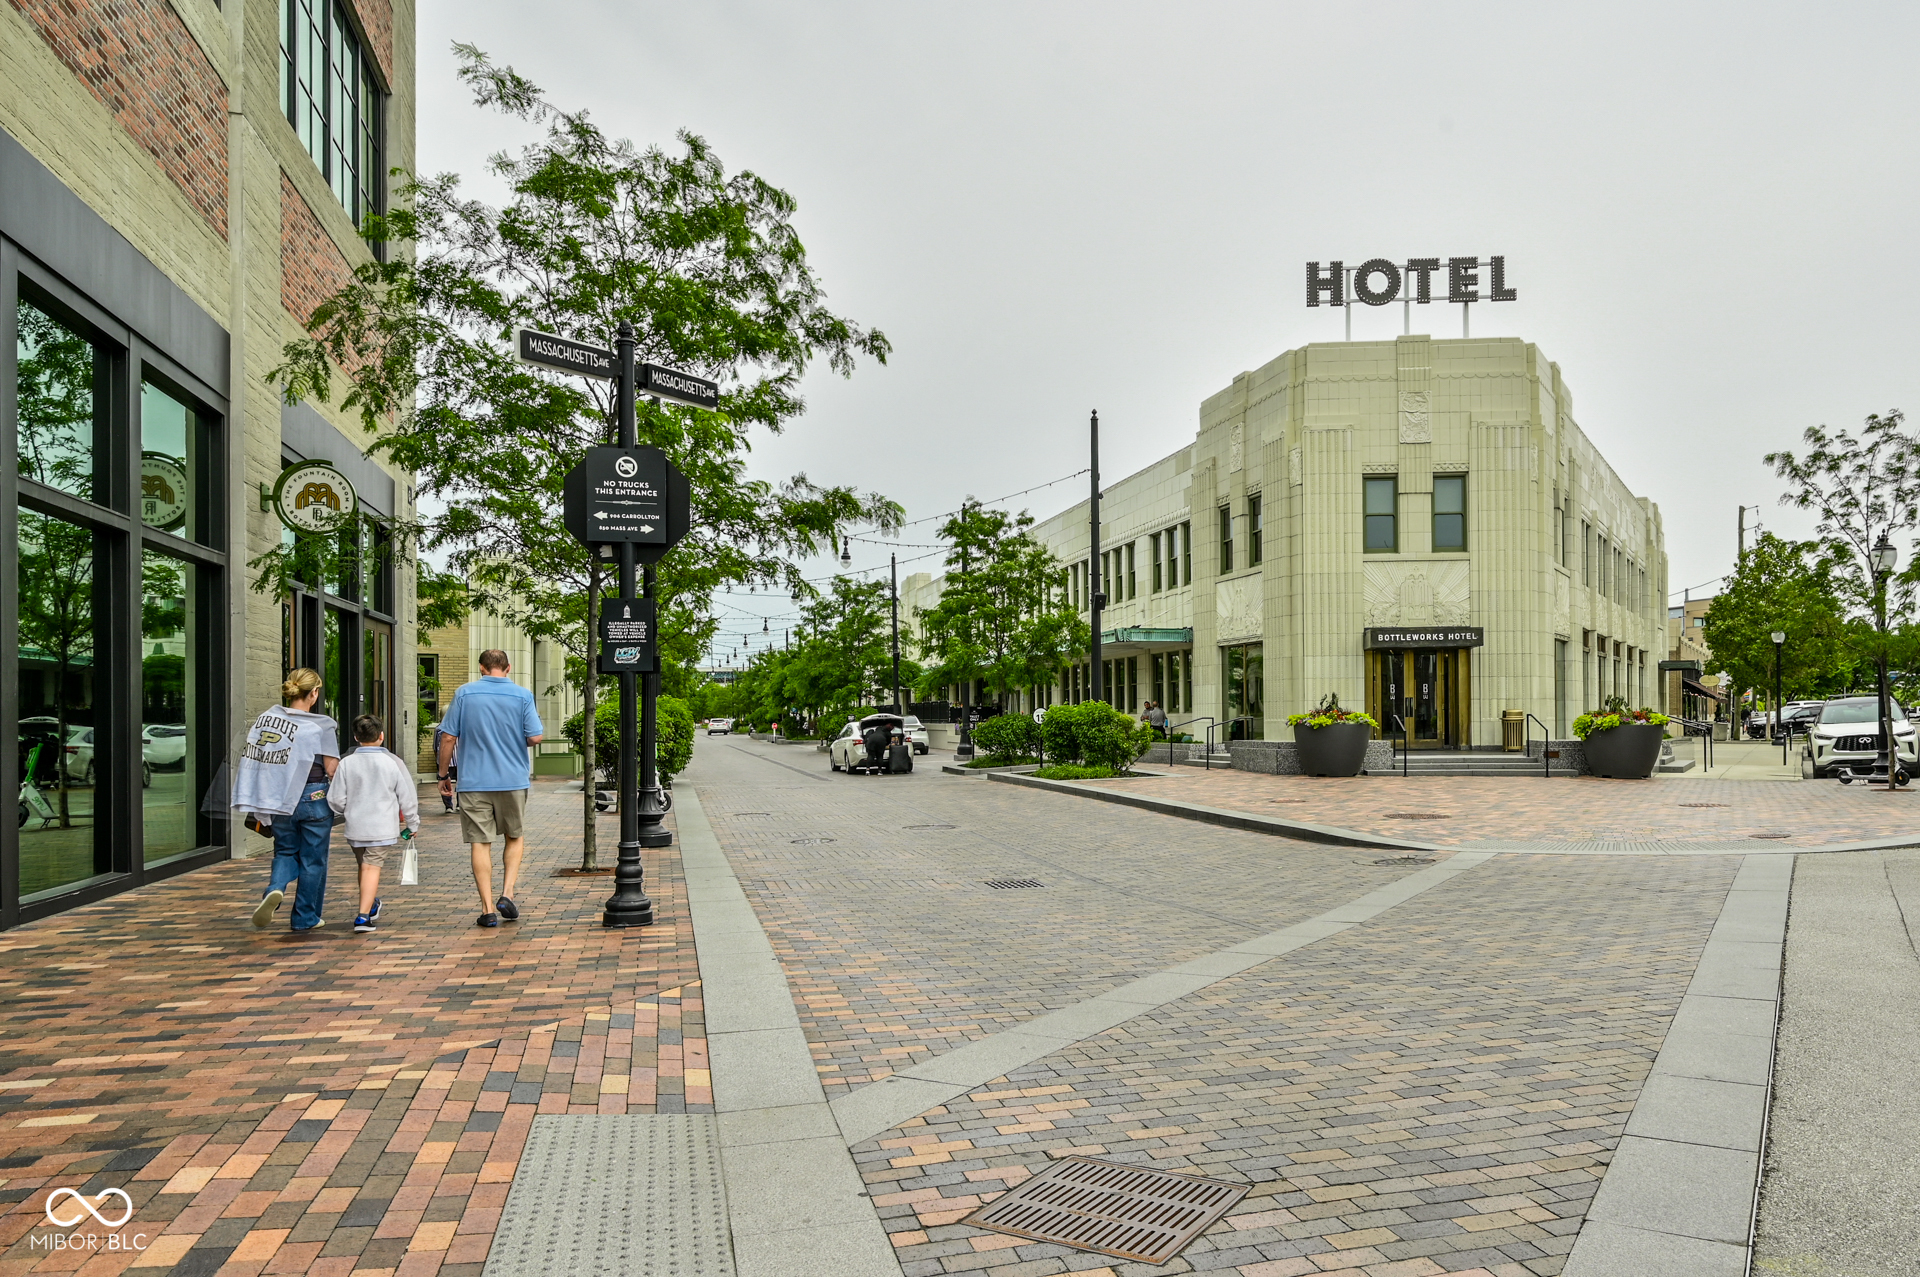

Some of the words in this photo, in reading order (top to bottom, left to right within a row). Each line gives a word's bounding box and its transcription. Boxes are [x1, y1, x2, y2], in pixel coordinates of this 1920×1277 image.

[1306, 255, 1517, 307] HOTEL
[529, 337, 598, 368] MASSACHUSETTS
[652, 370, 706, 398] MASSACHUSETTS
[285, 484, 294, 499] THE
[293, 471, 336, 482] FOUNTAIN
[338, 481, 350, 502] ROOM
[616, 488, 658, 496] ENTRANCE
[254, 716, 298, 743] URDUE
[256, 730, 282, 746] P
